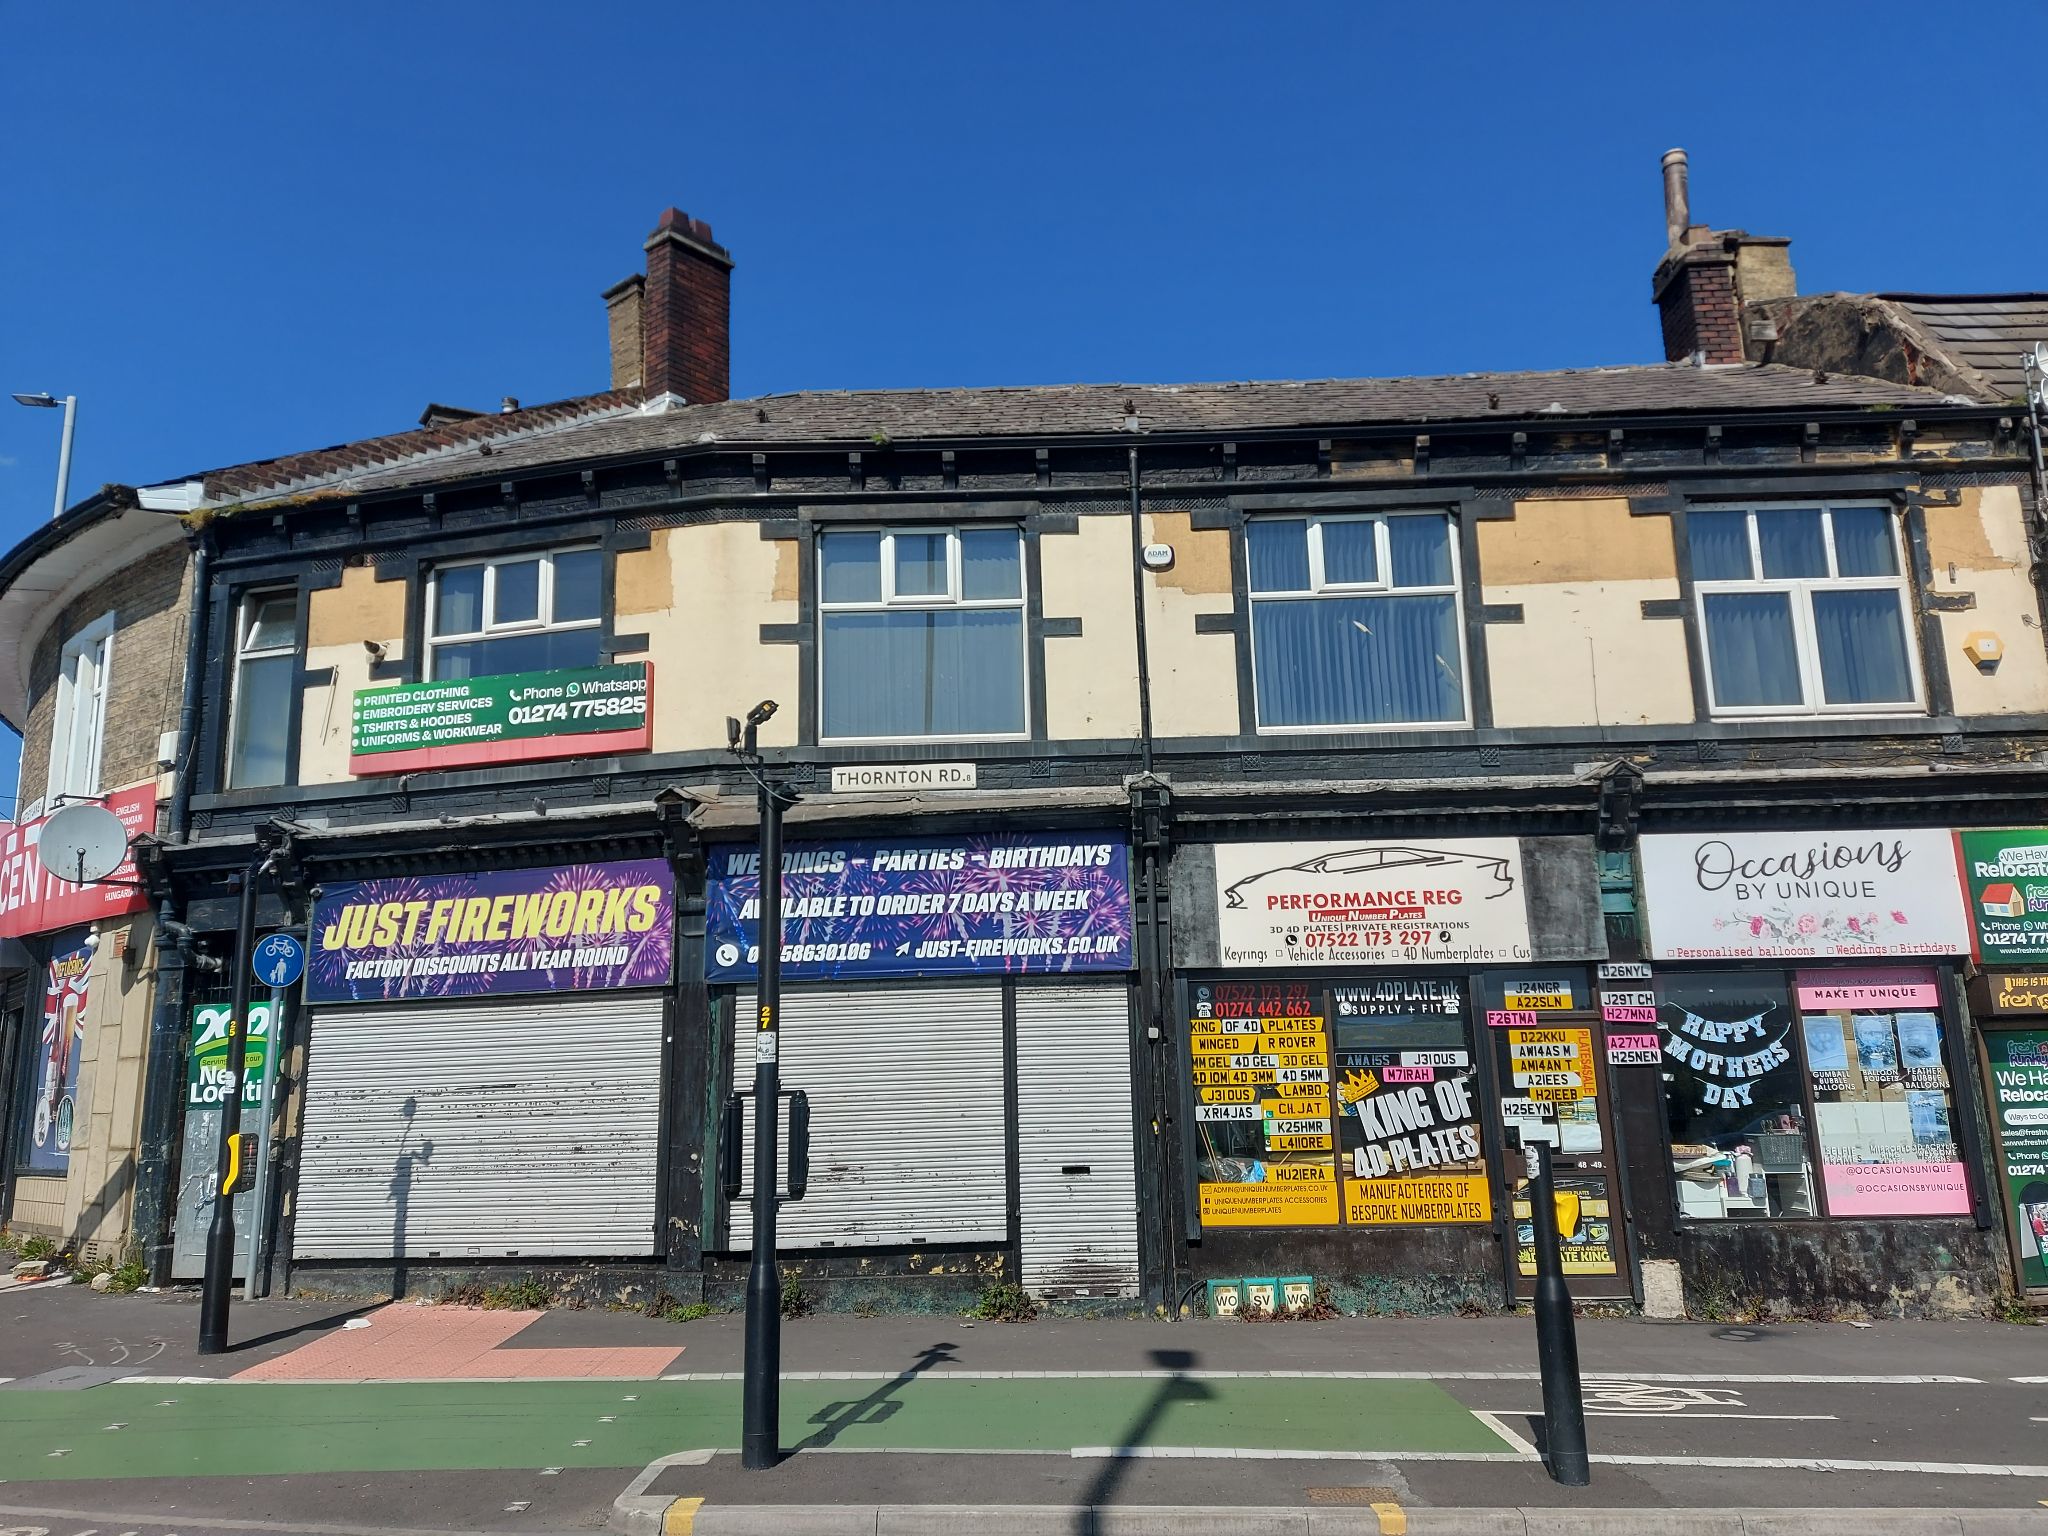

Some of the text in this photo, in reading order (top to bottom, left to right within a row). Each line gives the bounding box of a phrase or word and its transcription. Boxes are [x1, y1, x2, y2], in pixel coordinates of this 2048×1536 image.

[523, 679, 647, 700] Phone Whatsapp
[364, 686, 469, 706] PRINTED CLOTHING
[363, 698, 493, 720] EMBROIDERY SERVICES
[508, 696, 646, 725] 01274 775825
[362, 713, 472, 734] TSHIRTS & HOODIES
[361, 723, 502, 747] UNIFORMS & WORKWEAR
[837, 769, 932, 786] THORNTON
[939, 769, 966, 783] RD.
[115, 802, 140, 817] ENGLISH
[727, 845, 1112, 876] WEDINGS PARTIES BIRTHDAYS
[2001, 851, 2023, 862] We
[1694, 839, 1912, 892] Occasions
[1736, 881, 1876, 900] BY UNIQUE
[849, 895, 874, 915] TO
[877, 894, 944, 915] ORDER
[1015, 891, 1031, 911] A
[1034, 890, 1092, 911] WEEK
[1267, 889, 1463, 910] PERFORMANCE REG
[322, 885, 662, 951] JUST FIREWORKS
[1269, 926, 1283, 934] 3D
[1286, 925, 1300, 933] 4D
[1390, 921, 1470, 930] REGISTRATIONS
[1991, 922, 2021, 931] Phone
[1305, 930, 1432, 947] 07522 173 297
[1983, 933, 2028, 945] 01274
[746, 942, 872, 963] 058630106
[915, 936, 1120, 960] JUST-FIREWORKS.CO.UK
[1677, 946, 1756, 958] Personalised
[1836, 944, 1888, 957] Weddings
[1899, 942, 1957, 955] Birthdays
[1224, 948, 1268, 963] Keyrings
[1287, 946, 1324, 961] Vehicle
[1329, 947, 1386, 960] Accessories
[1404, 947, 1417, 959] 4D
[1421, 946, 1495, 963] Numberplates
[345, 946, 630, 980] FACTORY DISCOUNTS ALL YEAR ROUND
[1602, 966, 1649, 977] D26NYL
[1515, 982, 1561, 994] J24NGR
[2011, 977, 2039, 987] THIS IS
[1215, 984, 1310, 1000] 07522 173 297
[1814, 988, 1918, 999] MAKE IT UNIQUE
[1517, 996, 1562, 1008] A22SLN
[1604, 993, 1654, 1005] J29T CH
[1215, 1001, 1311, 1017] 01274 442 662
[1352, 1004, 1402, 1015] SUPPLY
[1422, 1004, 1442, 1014] FIT
[1607, 1008, 1654, 1020] H27MNA
[1488, 1013, 1534, 1025] F26TMA
[1191, 1021, 1216, 1032] KING
[1225, 1020, 1258, 1032] OF 4D
[1681, 1012, 1767, 1043] HAPPY
[1268, 1036, 1316, 1048] R ROVER
[1520, 1032, 1566, 1043] D22KKU
[1610, 1036, 1657, 1048] A27YLA
[1199, 1039, 1239, 1050] WINGED
[1563, 1046, 1571, 1056] M
[1611, 1051, 1658, 1062] H25NEN
[1664, 1034, 1790, 1078] MOTHERS
[1208, 1056, 1230, 1067] GEL
[1235, 1055, 1275, 1067] 4D GEL
[1283, 1055, 1323, 1066] 3D GEL
[1565, 1060, 1572, 1070] T
[1577, 1030, 1595, 1094] PLATES4SALE
[1193, 1071, 1206, 1082] 4D
[1233, 1070, 1274, 1082] 4D 3MM
[1283, 1069, 1323, 1081] 4D 5MM
[1907, 1067, 1943, 1075] FEATHER
[1912, 1074, 1942, 1082] BUBBLE
[1996, 1071, 2027, 1086] We
[1284, 1085, 1322, 1096] LAMBO
[1905, 1081, 1950, 1089] BALLOONS
[1703, 1082, 1753, 1109] DAY
[1356, 1077, 1473, 1141] KING OF
[1504, 1103, 1551, 1115] H25EYN
[2008, 1113, 2029, 1122] Ways
[1278, 1121, 1323, 1133] K25HMR
[1354, 1144, 1389, 1179] 4D
[1388, 1125, 1480, 1173] PLATES
[2016, 1152, 2040, 1160] Phone
[1578, 1161, 1587, 1169] 48
[1846, 1165, 1952, 1175] @OCCASIONSUNIQUE
[2007, 1164, 2045, 1176] 01274
[1359, 1183, 1470, 1200] MANUFACTERERS OF
[1856, 1183, 1965, 1193] @OCCASIONSBYUNIQUE
[1352, 1202, 1482, 1221] BESPOKE NUMBERPLATES
[1581, 1251, 1610, 1262] KING
[1216, 1295, 1238, 1306] WO
[1253, 1294, 1270, 1306] SV
